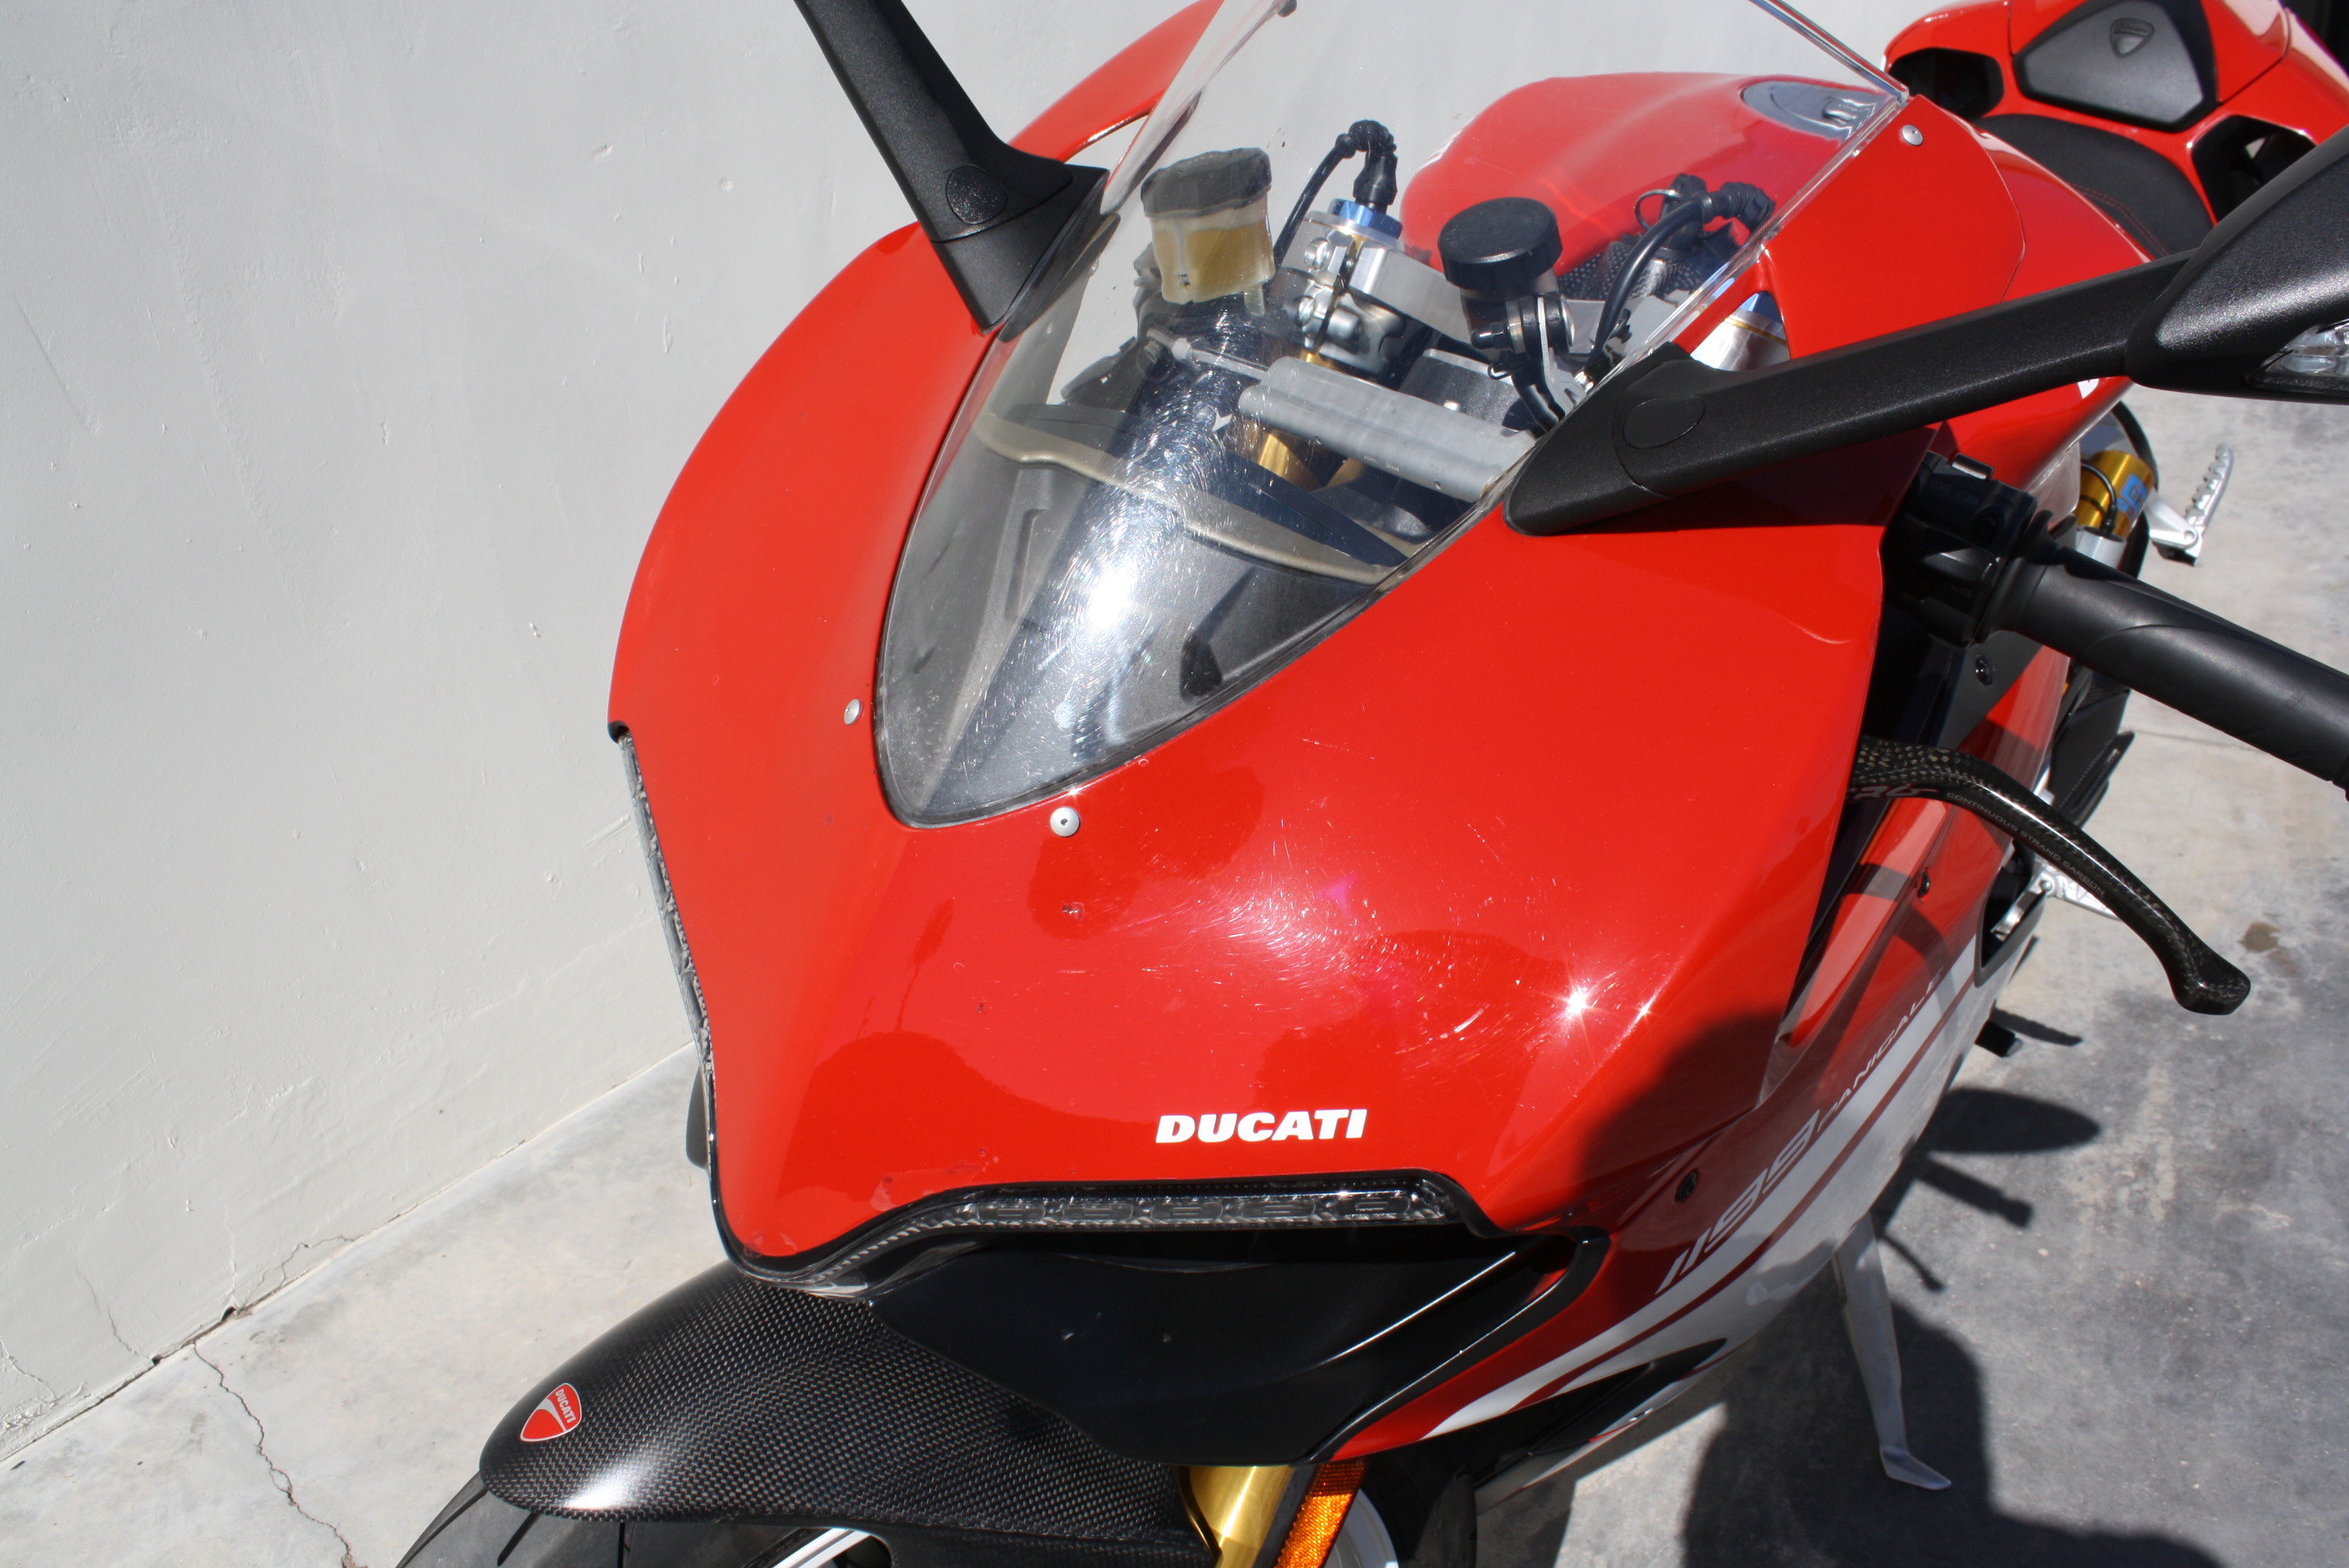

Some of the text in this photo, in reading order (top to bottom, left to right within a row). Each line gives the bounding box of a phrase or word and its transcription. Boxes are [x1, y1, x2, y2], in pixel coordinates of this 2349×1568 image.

[1947, 792, 2106, 897] CONTINUOUS STRAND CARBON
[1155, 1108, 1367, 1143] DUCATI
[1655, 966, 1944, 1295] 1199 PANIGALE
[556, 1389, 576, 1423] DUCATI
